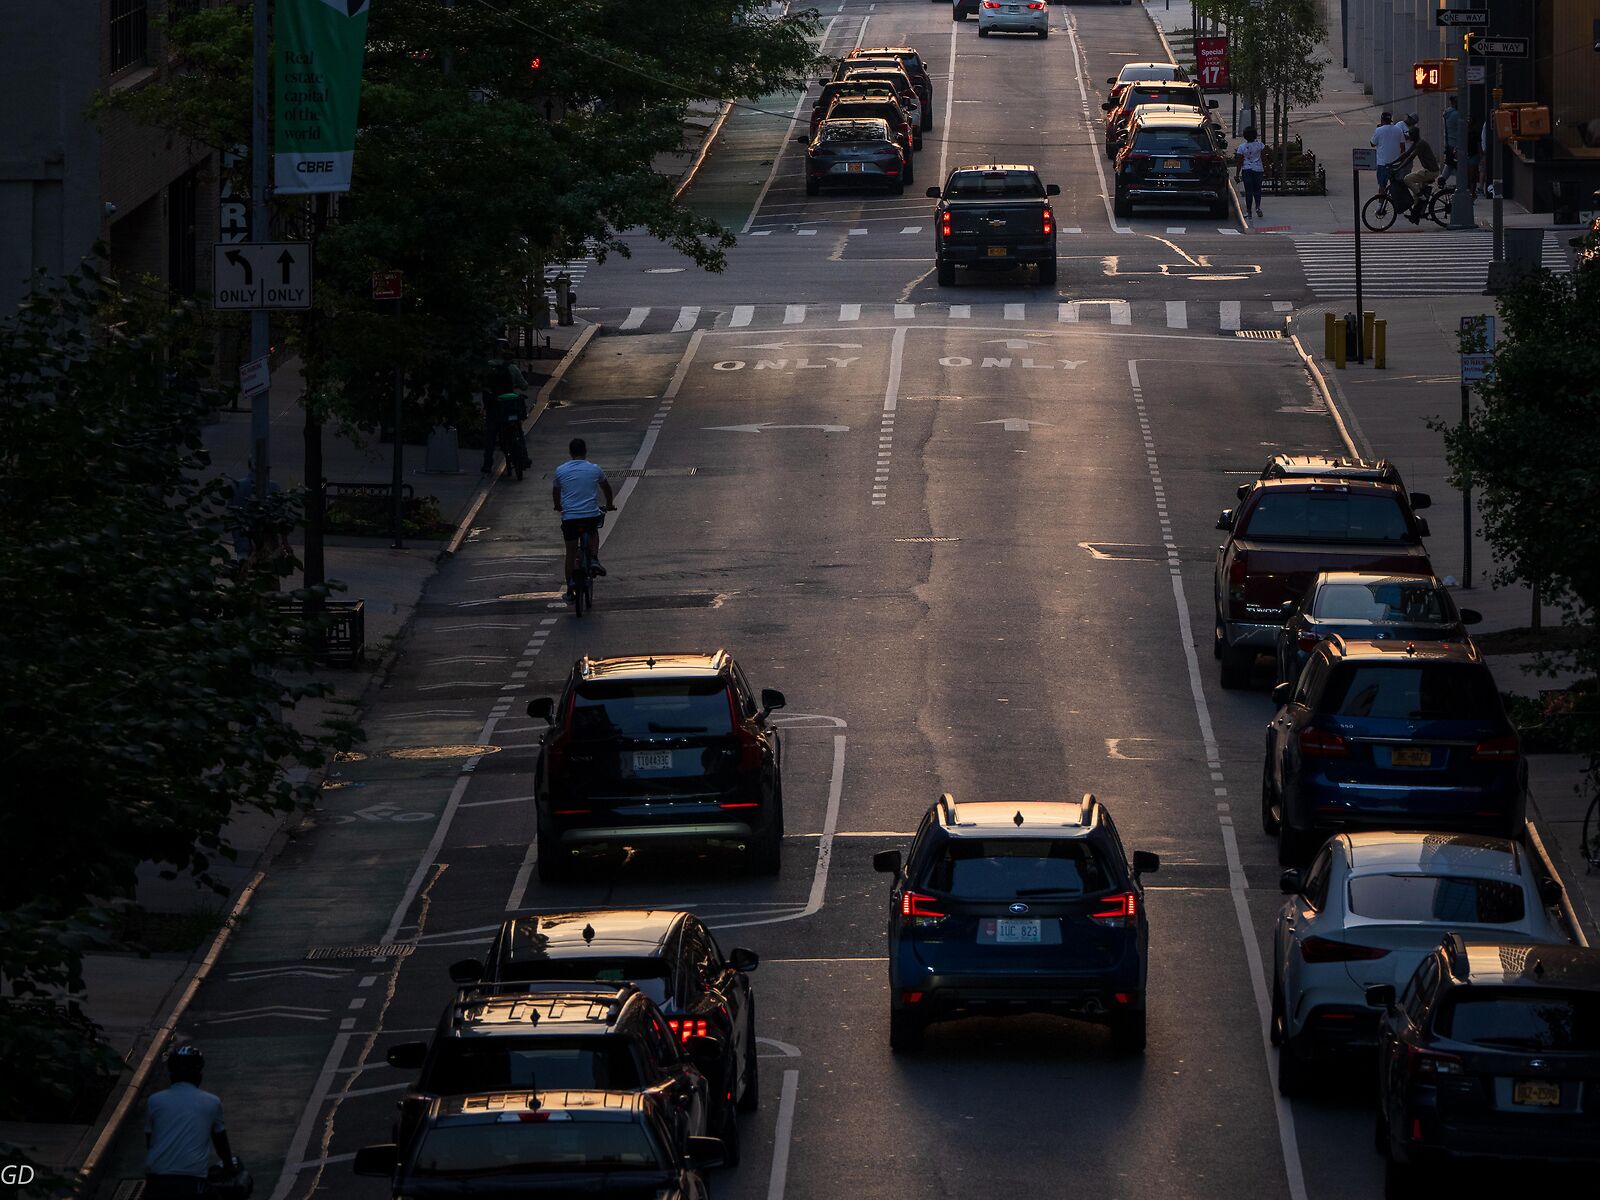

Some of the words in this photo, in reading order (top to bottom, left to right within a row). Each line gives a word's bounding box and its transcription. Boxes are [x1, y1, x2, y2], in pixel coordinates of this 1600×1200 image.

[1443, 14, 1459, 22] ONE
[1466, 14, 1483, 22] WAY
[1201, 48, 1224, 57] Special
[1477, 42, 1494, 51] ONE
[1502, 43, 1521, 52] WAY
[284, 50, 314, 65] Real
[284, 71, 323, 84] estate
[1202, 67, 1220, 84] 17
[1429, 69, 1438, 85] 10
[284, 89, 329, 105] capital
[284, 107, 299, 122] of
[300, 107, 321, 122] the
[284, 126, 321, 141] world
[296, 160, 334, 173] CBRE
[220, 290, 257, 303] ONLY
[268, 289, 304, 302] ONLY
[713, 356, 861, 372] ONLY
[938, 355, 1089, 371] ONLY
[1021, 925, 1038, 937] 823
